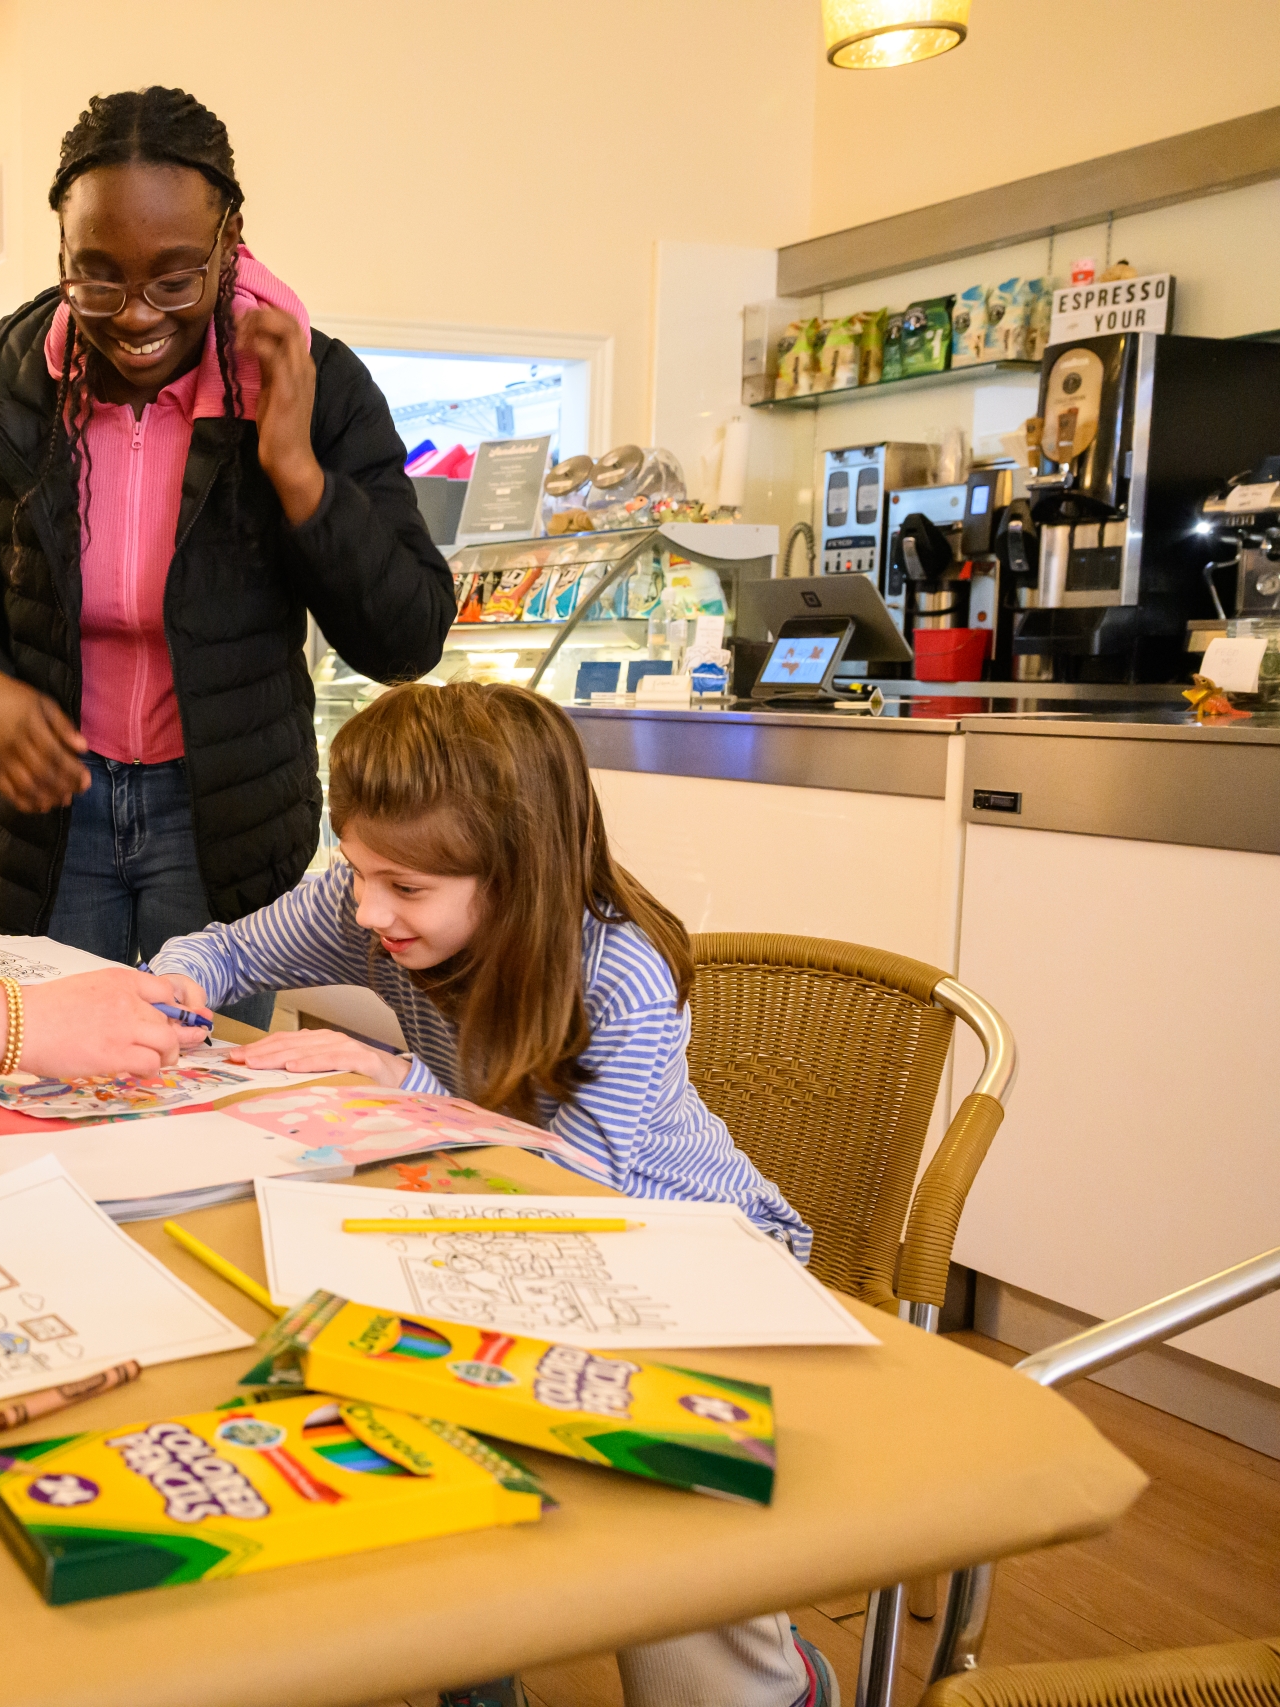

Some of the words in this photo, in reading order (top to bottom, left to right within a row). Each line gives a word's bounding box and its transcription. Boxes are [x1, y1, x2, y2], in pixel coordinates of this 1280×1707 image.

[1058, 280, 1165, 313] ESPRESSO
[1095, 308, 1146, 332] YOUR
[533, 1343, 591, 1411] COLORED
[577, 1355, 642, 1420] PENCILS
[346, 1403, 433, 1469] Crayola
[104, 1431, 227, 1523] PENCILS
[144, 1422, 271, 1519] COLORED
